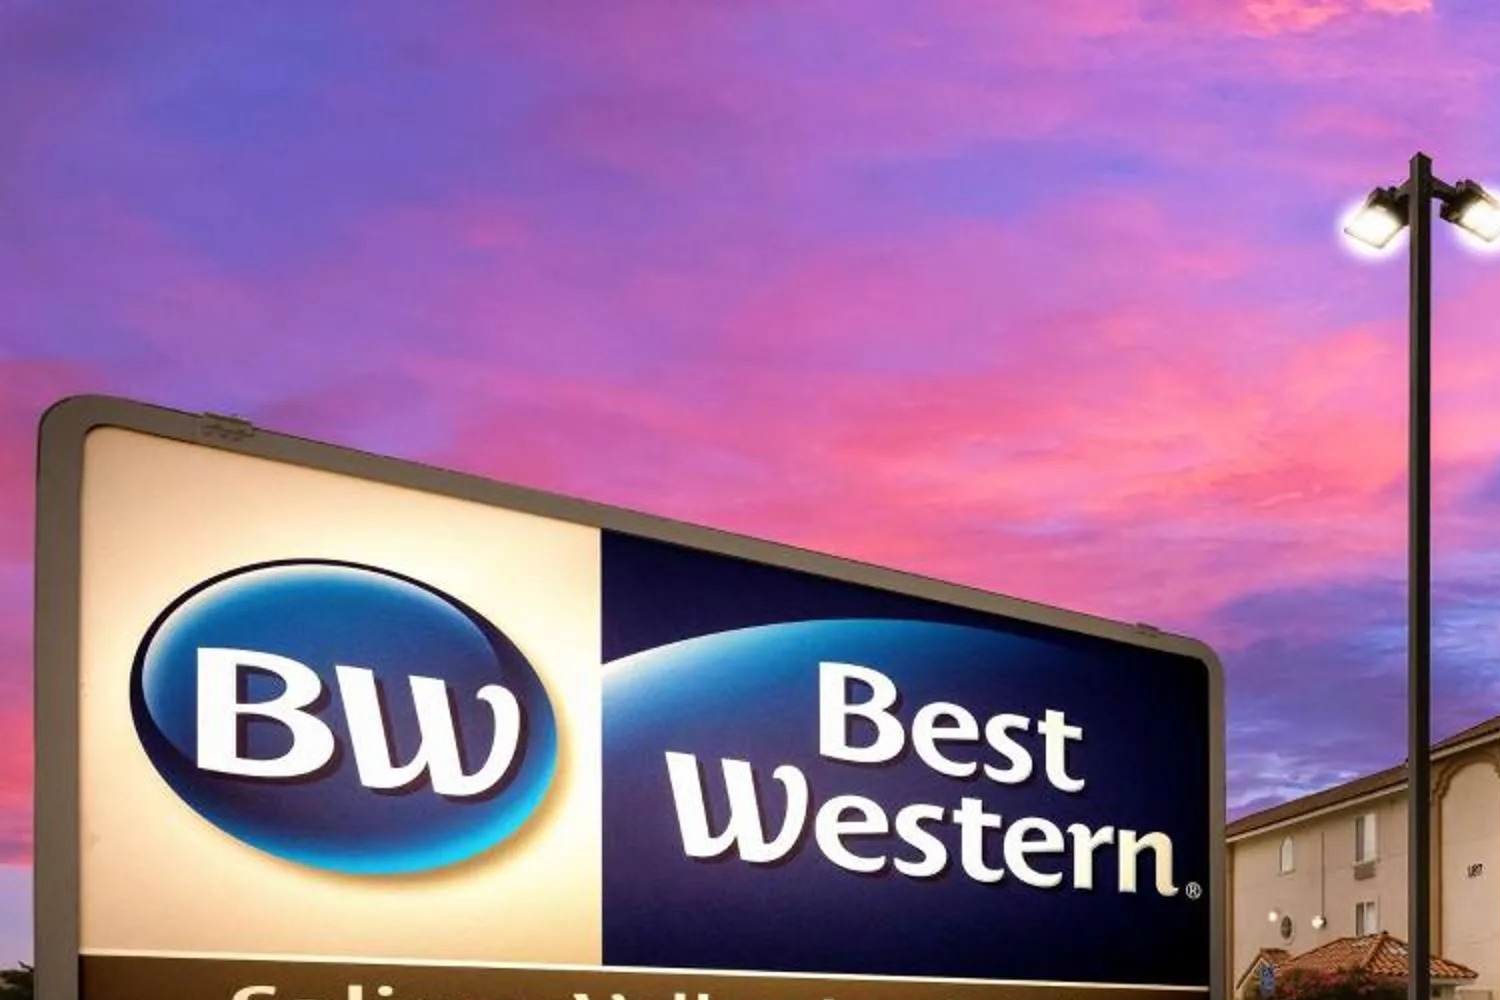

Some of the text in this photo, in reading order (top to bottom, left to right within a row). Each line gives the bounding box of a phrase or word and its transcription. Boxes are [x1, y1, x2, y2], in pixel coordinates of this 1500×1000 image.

[198, 648, 520, 797] BW
[819, 661, 1085, 792] Best
[665, 751, 1179, 897] Western
